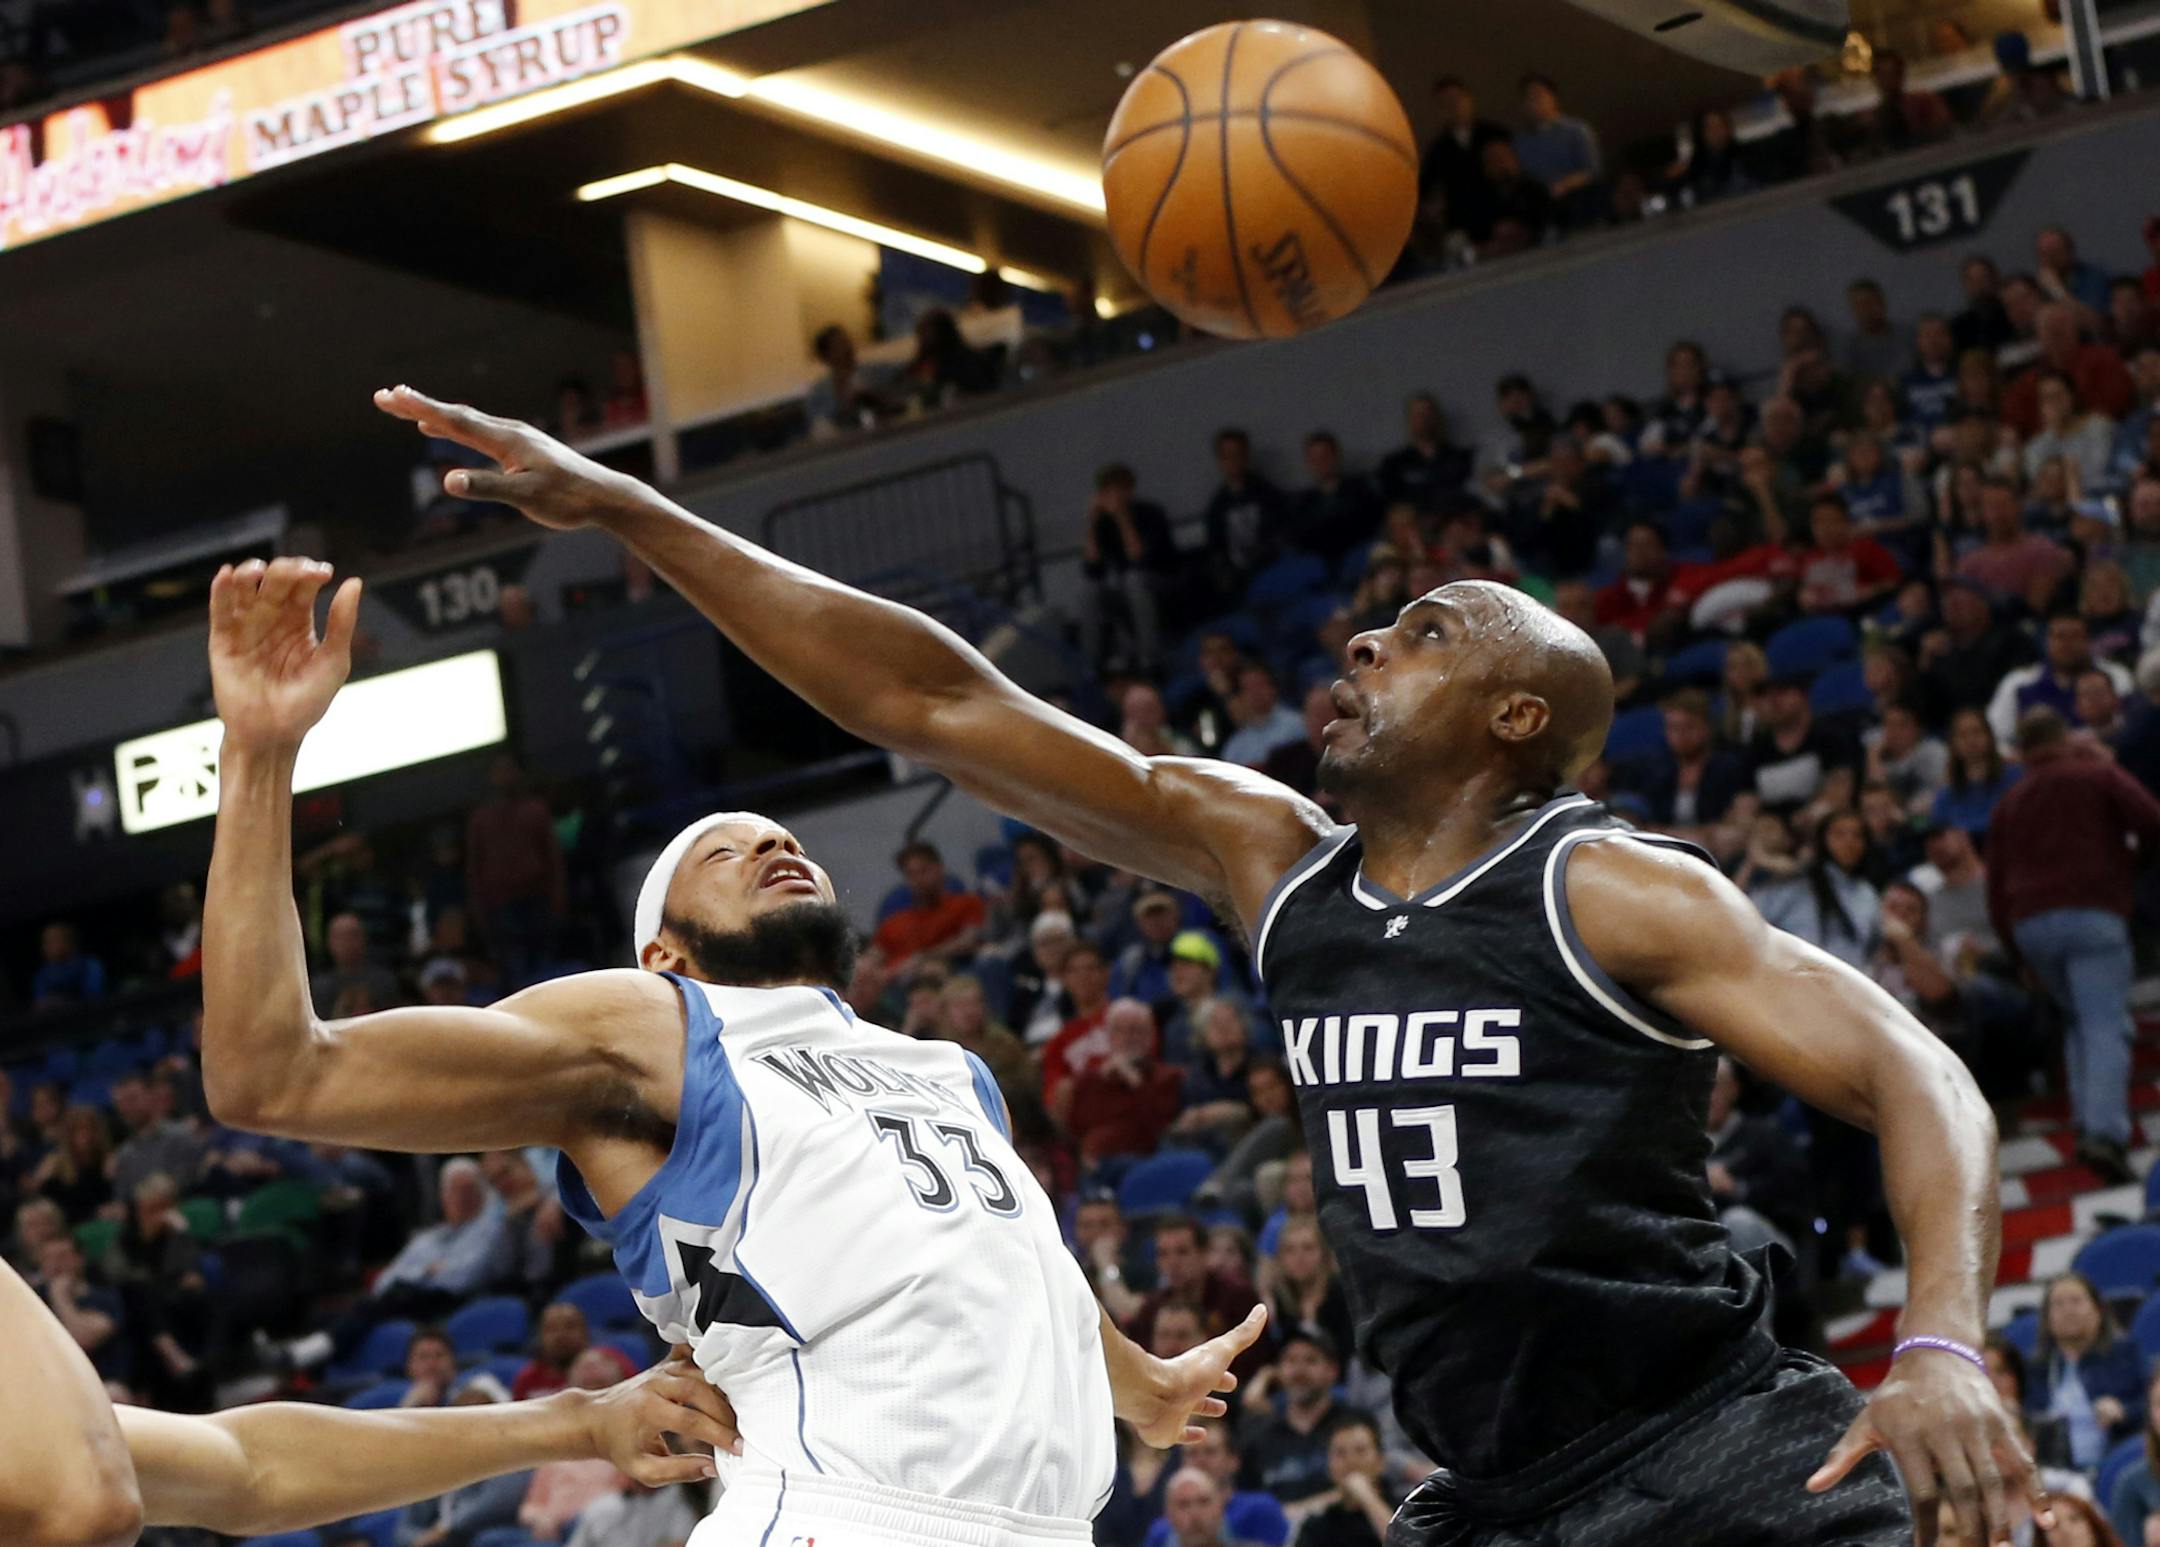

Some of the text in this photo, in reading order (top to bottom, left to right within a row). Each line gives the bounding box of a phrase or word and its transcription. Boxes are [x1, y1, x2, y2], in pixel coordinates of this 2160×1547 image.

[353, 0, 503, 76] PURE
[254, 13, 621, 155] MAPLE SYRUP
[1885, 175, 1979, 241] 131
[418, 566, 499, 626] 130
[1281, 1008, 1522, 1087] KINGS
[865, 1108, 1025, 1219] 33
[1326, 1104, 1467, 1230] 43
